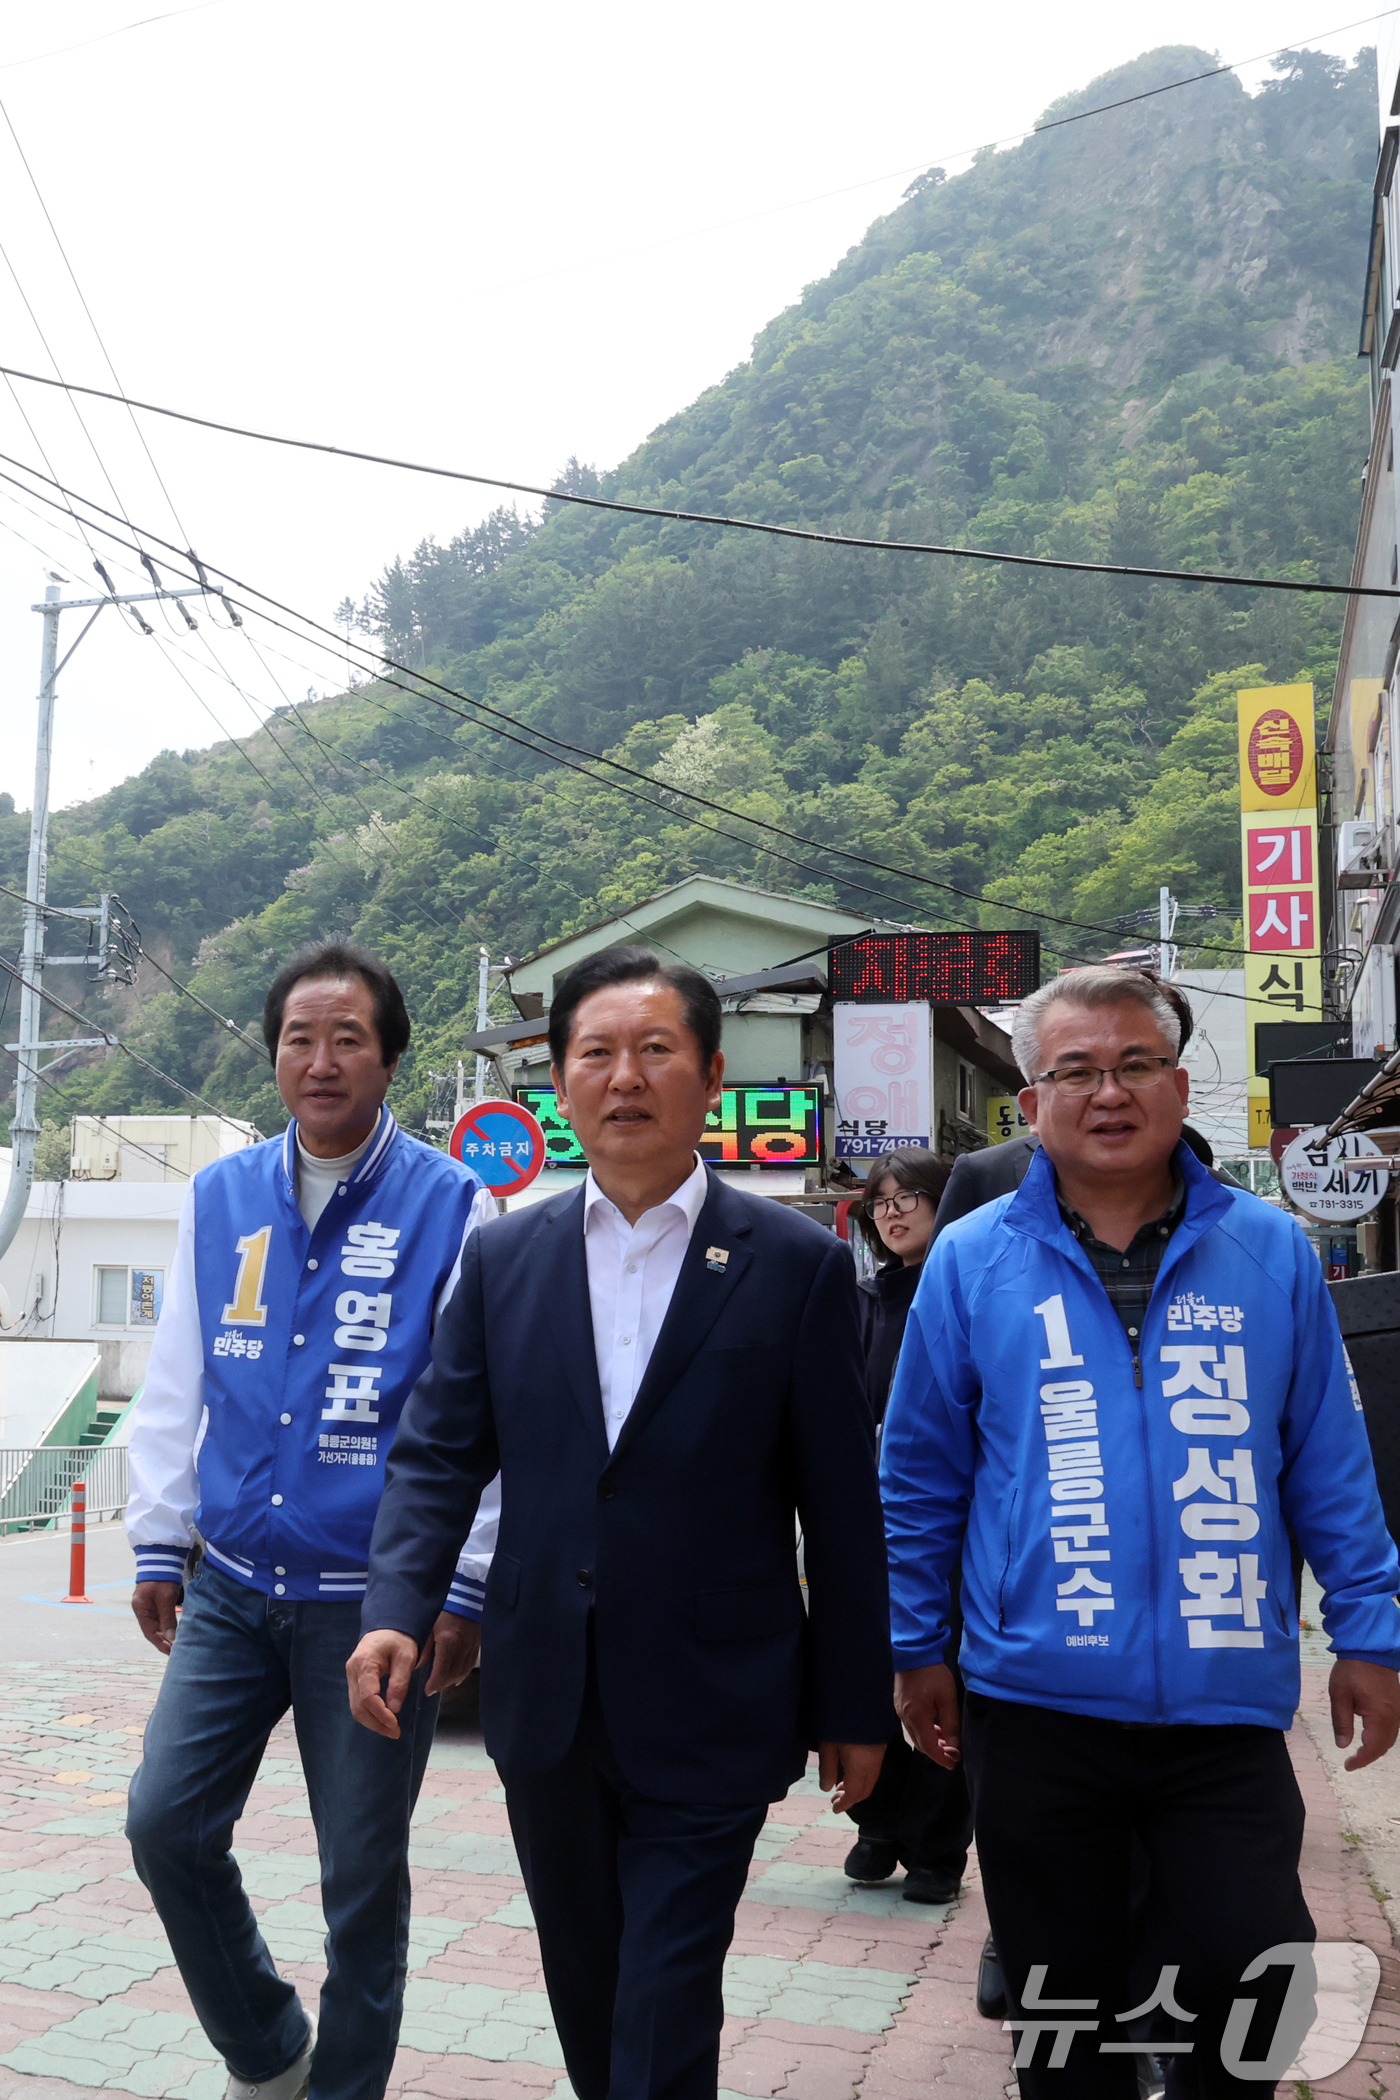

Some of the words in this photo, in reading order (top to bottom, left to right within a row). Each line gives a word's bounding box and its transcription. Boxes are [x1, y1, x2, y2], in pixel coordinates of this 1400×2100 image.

[1256, 719, 1293, 785] 신속배달
[1255, 830, 1309, 1022] 기사식
[844, 1012, 918, 1132] 정애
[836, 1119, 889, 1136] 식당
[465, 1140, 531, 1158] 주차금지
[1291, 1171, 1317, 1181] 가정식
[1292, 1181, 1318, 1193] 백반
[1319, 1199, 1364, 1210] 791-3315
[220, 1225, 273, 1327] 1
[1174, 1291, 1206, 1307] 더불어
[321, 1221, 400, 1424] 홍영표
[1033, 1293, 1085, 1370] 1
[1166, 1304, 1245, 1334] 민주당
[212, 1336, 264, 1360] 민주당
[1039, 1379, 1116, 1627] 울릉군수
[1159, 1344, 1268, 1650] 정성환
[1065, 1634, 1110, 1647] 예비후보
